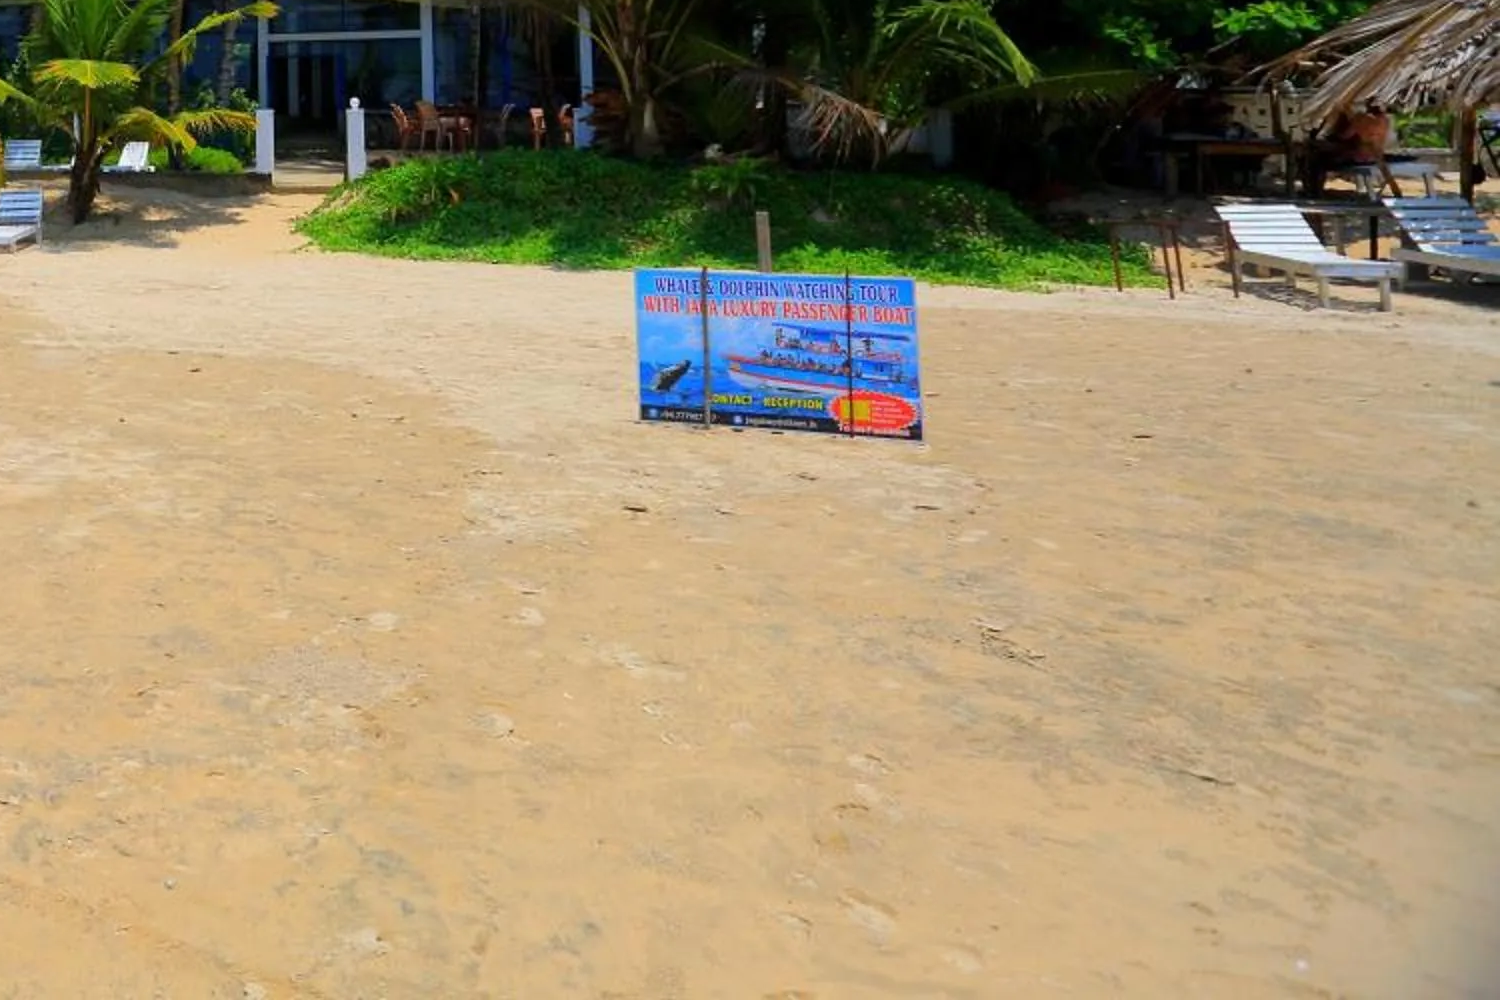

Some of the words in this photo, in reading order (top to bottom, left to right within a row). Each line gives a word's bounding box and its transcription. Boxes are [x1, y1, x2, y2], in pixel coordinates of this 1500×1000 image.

[655, 277, 701, 295] WHALE
[719, 280, 779, 297] DOLPHIN
[783, 281, 855, 301] WATCHING
[860, 285, 897, 303] TOUR
[644, 295, 679, 313] WITH
[723, 300, 777, 318] LUXURY
[783, 302, 869, 322] PASSENGER
[873, 306, 913, 325] BOAT
[764, 396, 823, 411] RECEPTION
